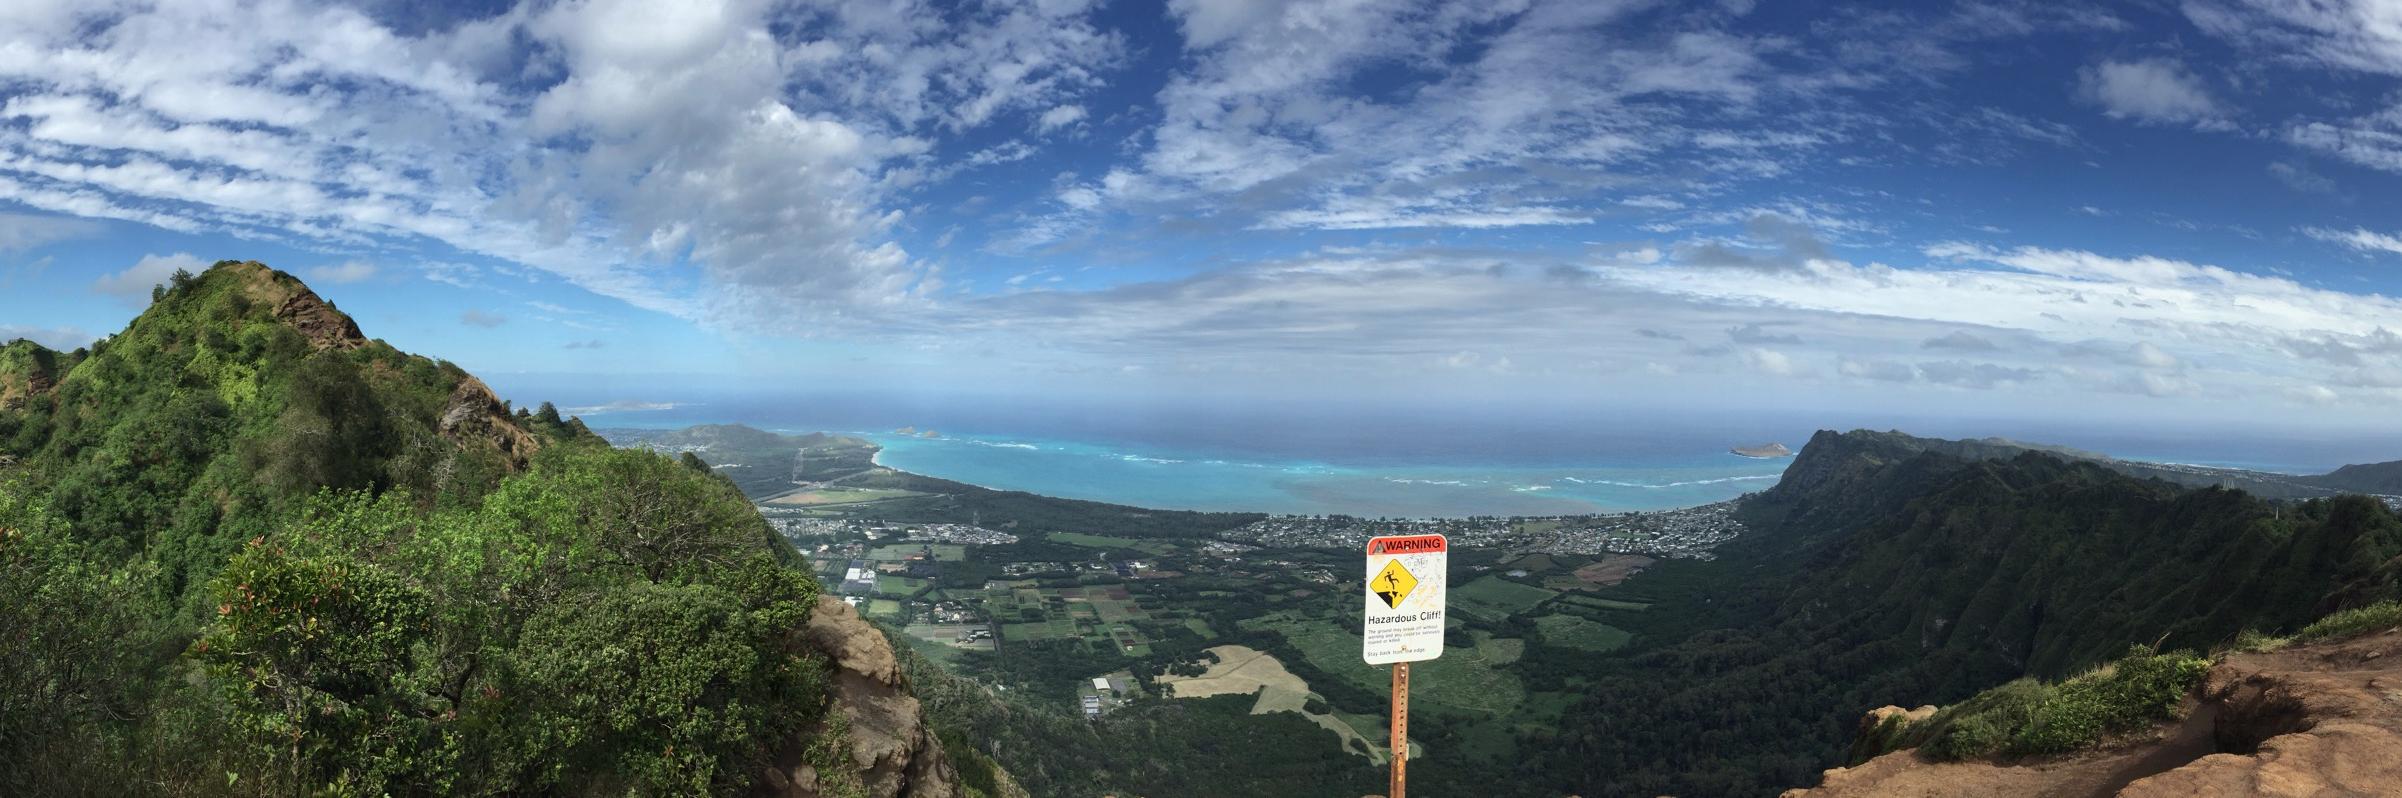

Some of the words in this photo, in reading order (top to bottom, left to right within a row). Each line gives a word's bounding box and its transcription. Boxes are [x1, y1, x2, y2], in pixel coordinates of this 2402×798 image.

[1386, 538, 1440, 550] WARNING
[1368, 614, 1416, 624] Hazardous
[1420, 611, 1440, 620] Cliff!
